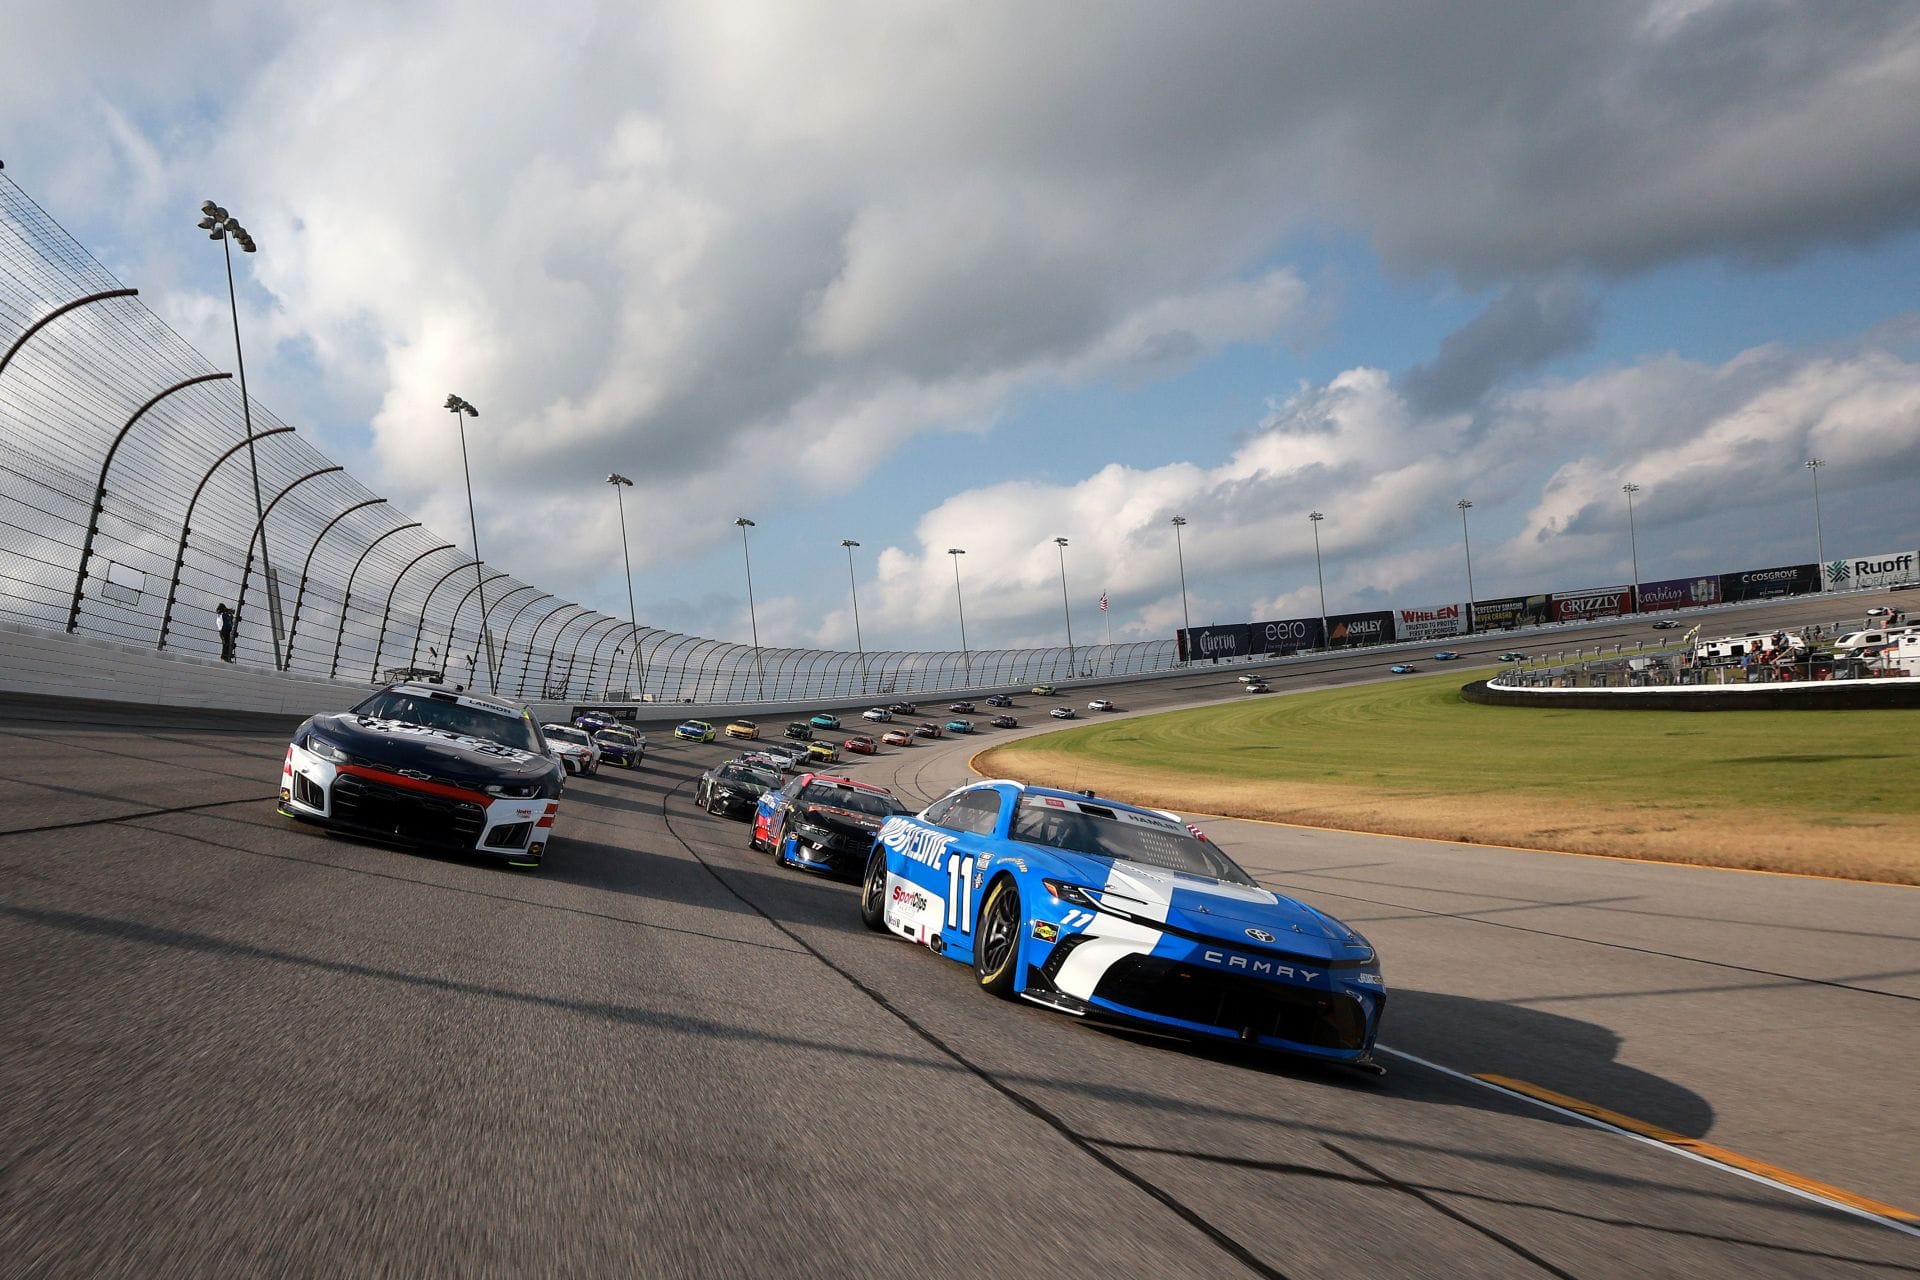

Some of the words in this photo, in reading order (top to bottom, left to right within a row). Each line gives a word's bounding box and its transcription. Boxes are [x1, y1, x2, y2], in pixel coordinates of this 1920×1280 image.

[1855, 555, 1912, 576] Ruoff
[1751, 569, 1798, 581] COSGROVE
[1560, 595, 1621, 612] GRIZZLY
[1401, 604, 1459, 623] WHELEN
[1265, 621, 1306, 641] eero
[1346, 620, 1382, 634] ASHLEY
[1405, 622, 1428, 631] TRUSTED
[1437, 620, 1459, 628] PROTECT
[1409, 629, 1424, 637] FIRST
[1424, 626, 1458, 636] RESPONDERS
[1200, 630, 1236, 654] Cuervo
[468, 699, 510, 714] LARSON
[1128, 814, 1180, 831] HAMLIN
[811, 841, 824, 851] 17
[947, 852, 975, 935] 11
[1060, 909, 1094, 928] 11
[1204, 950, 1320, 982] CAMRY
